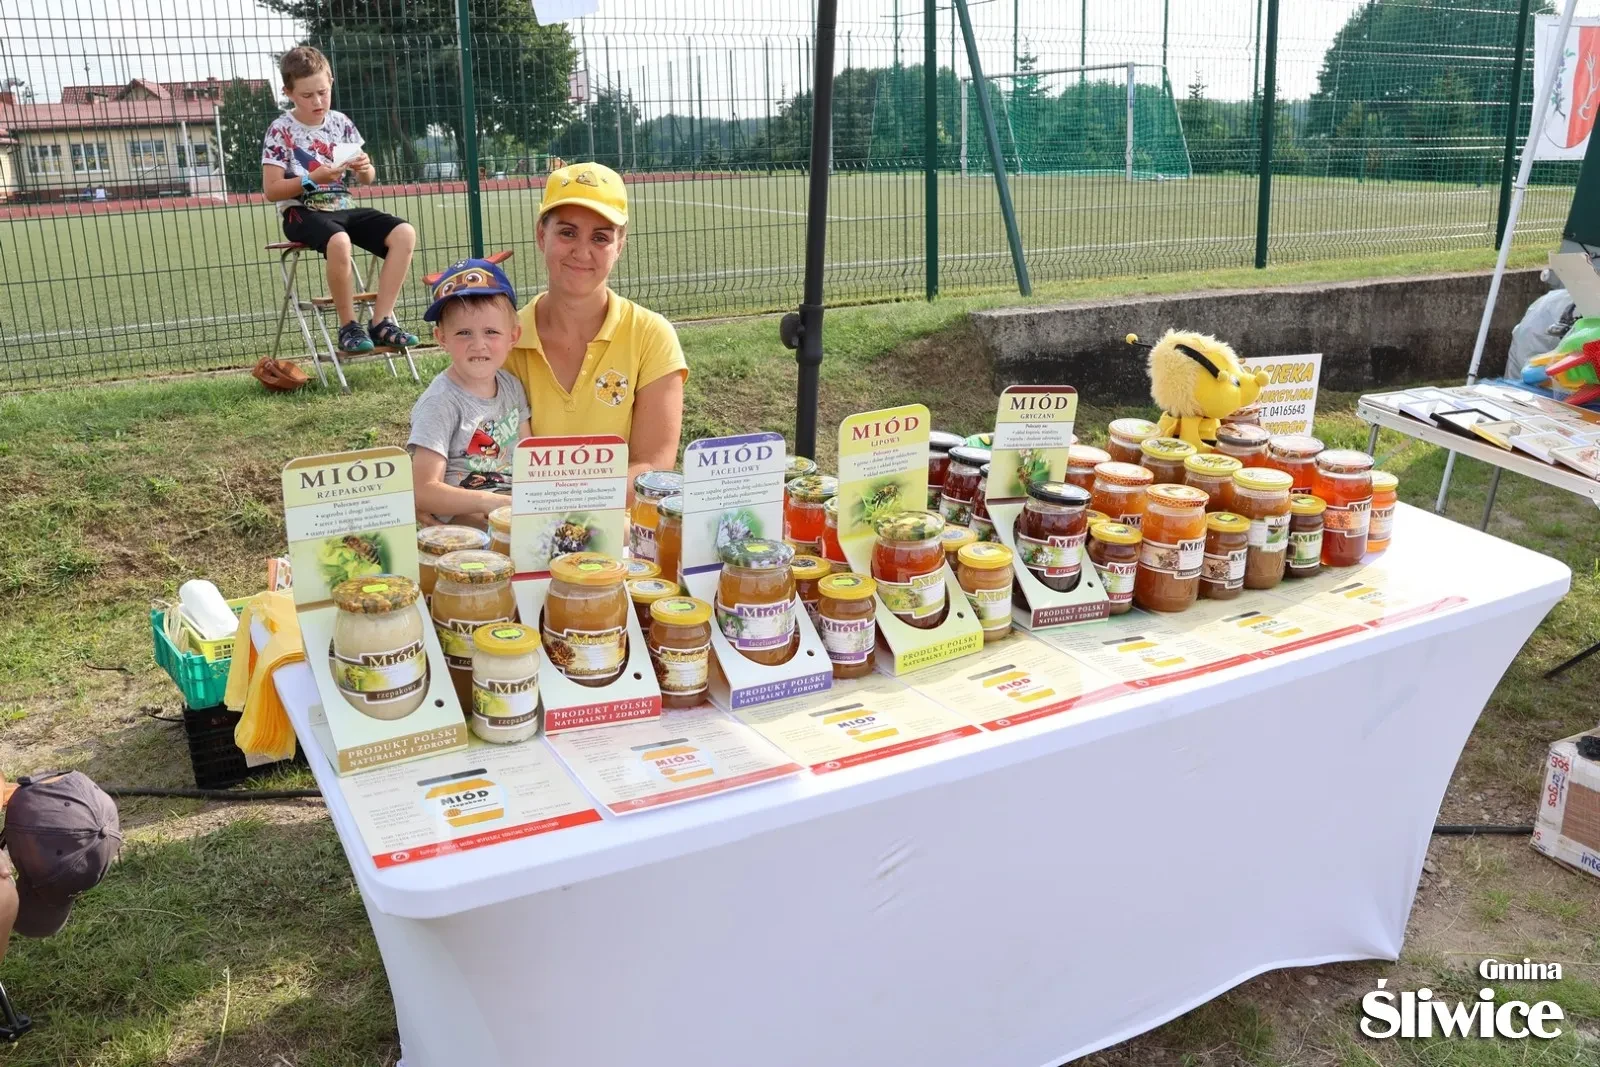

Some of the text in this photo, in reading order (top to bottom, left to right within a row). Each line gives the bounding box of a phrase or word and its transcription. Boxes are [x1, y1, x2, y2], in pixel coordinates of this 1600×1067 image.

[1010, 393, 1068, 410] MIÓD
[852, 416, 919, 441] MIÓD
[871, 437, 900, 447] LIPOWY
[528, 445, 614, 467] MIÓD
[697, 443, 773, 467] MIÓD
[299, 459, 396, 489] MIÓD
[528, 467, 615, 478] WIELOKWIATOWY
[711, 464, 760, 476] FACELIOWY
[317, 483, 384, 499] RZEPAKOWY
[742, 603, 786, 618] Miód
[1039, 603, 1105, 618] PRODUKT POLSKI
[1039, 615, 1073, 624] NATURALNY
[1079, 611, 1104, 619] ZDROWY
[821, 621, 862, 633] Miód
[570, 631, 617, 645] Miód
[663, 648, 707, 662] Miód
[903, 634, 978, 661] PRODUKT POLSKI
[903, 652, 942, 668] NATURALNY
[948, 642, 977, 655] ZDROWY
[368, 645, 417, 668] Miód
[376, 683, 417, 699] rzepakowy
[739, 674, 826, 698] PRODUKT POLSKI
[997, 678, 1031, 691] MIÓD
[739, 691, 785, 705] NATURALNY
[792, 683, 825, 694] ZDROWY
[553, 700, 653, 720] PRODUKT POLSKI
[554, 714, 607, 727] NATURALNY
[615, 708, 653, 719] ZDROWY
[837, 716, 876, 728] MIÓD
[348, 727, 457, 759] PRODUKT POLSKI
[350, 748, 407, 767] NATURALNY
[417, 737, 458, 752] ZDROWY
[655, 754, 696, 767] MIÓD
[440, 790, 489, 806] MIÓD
